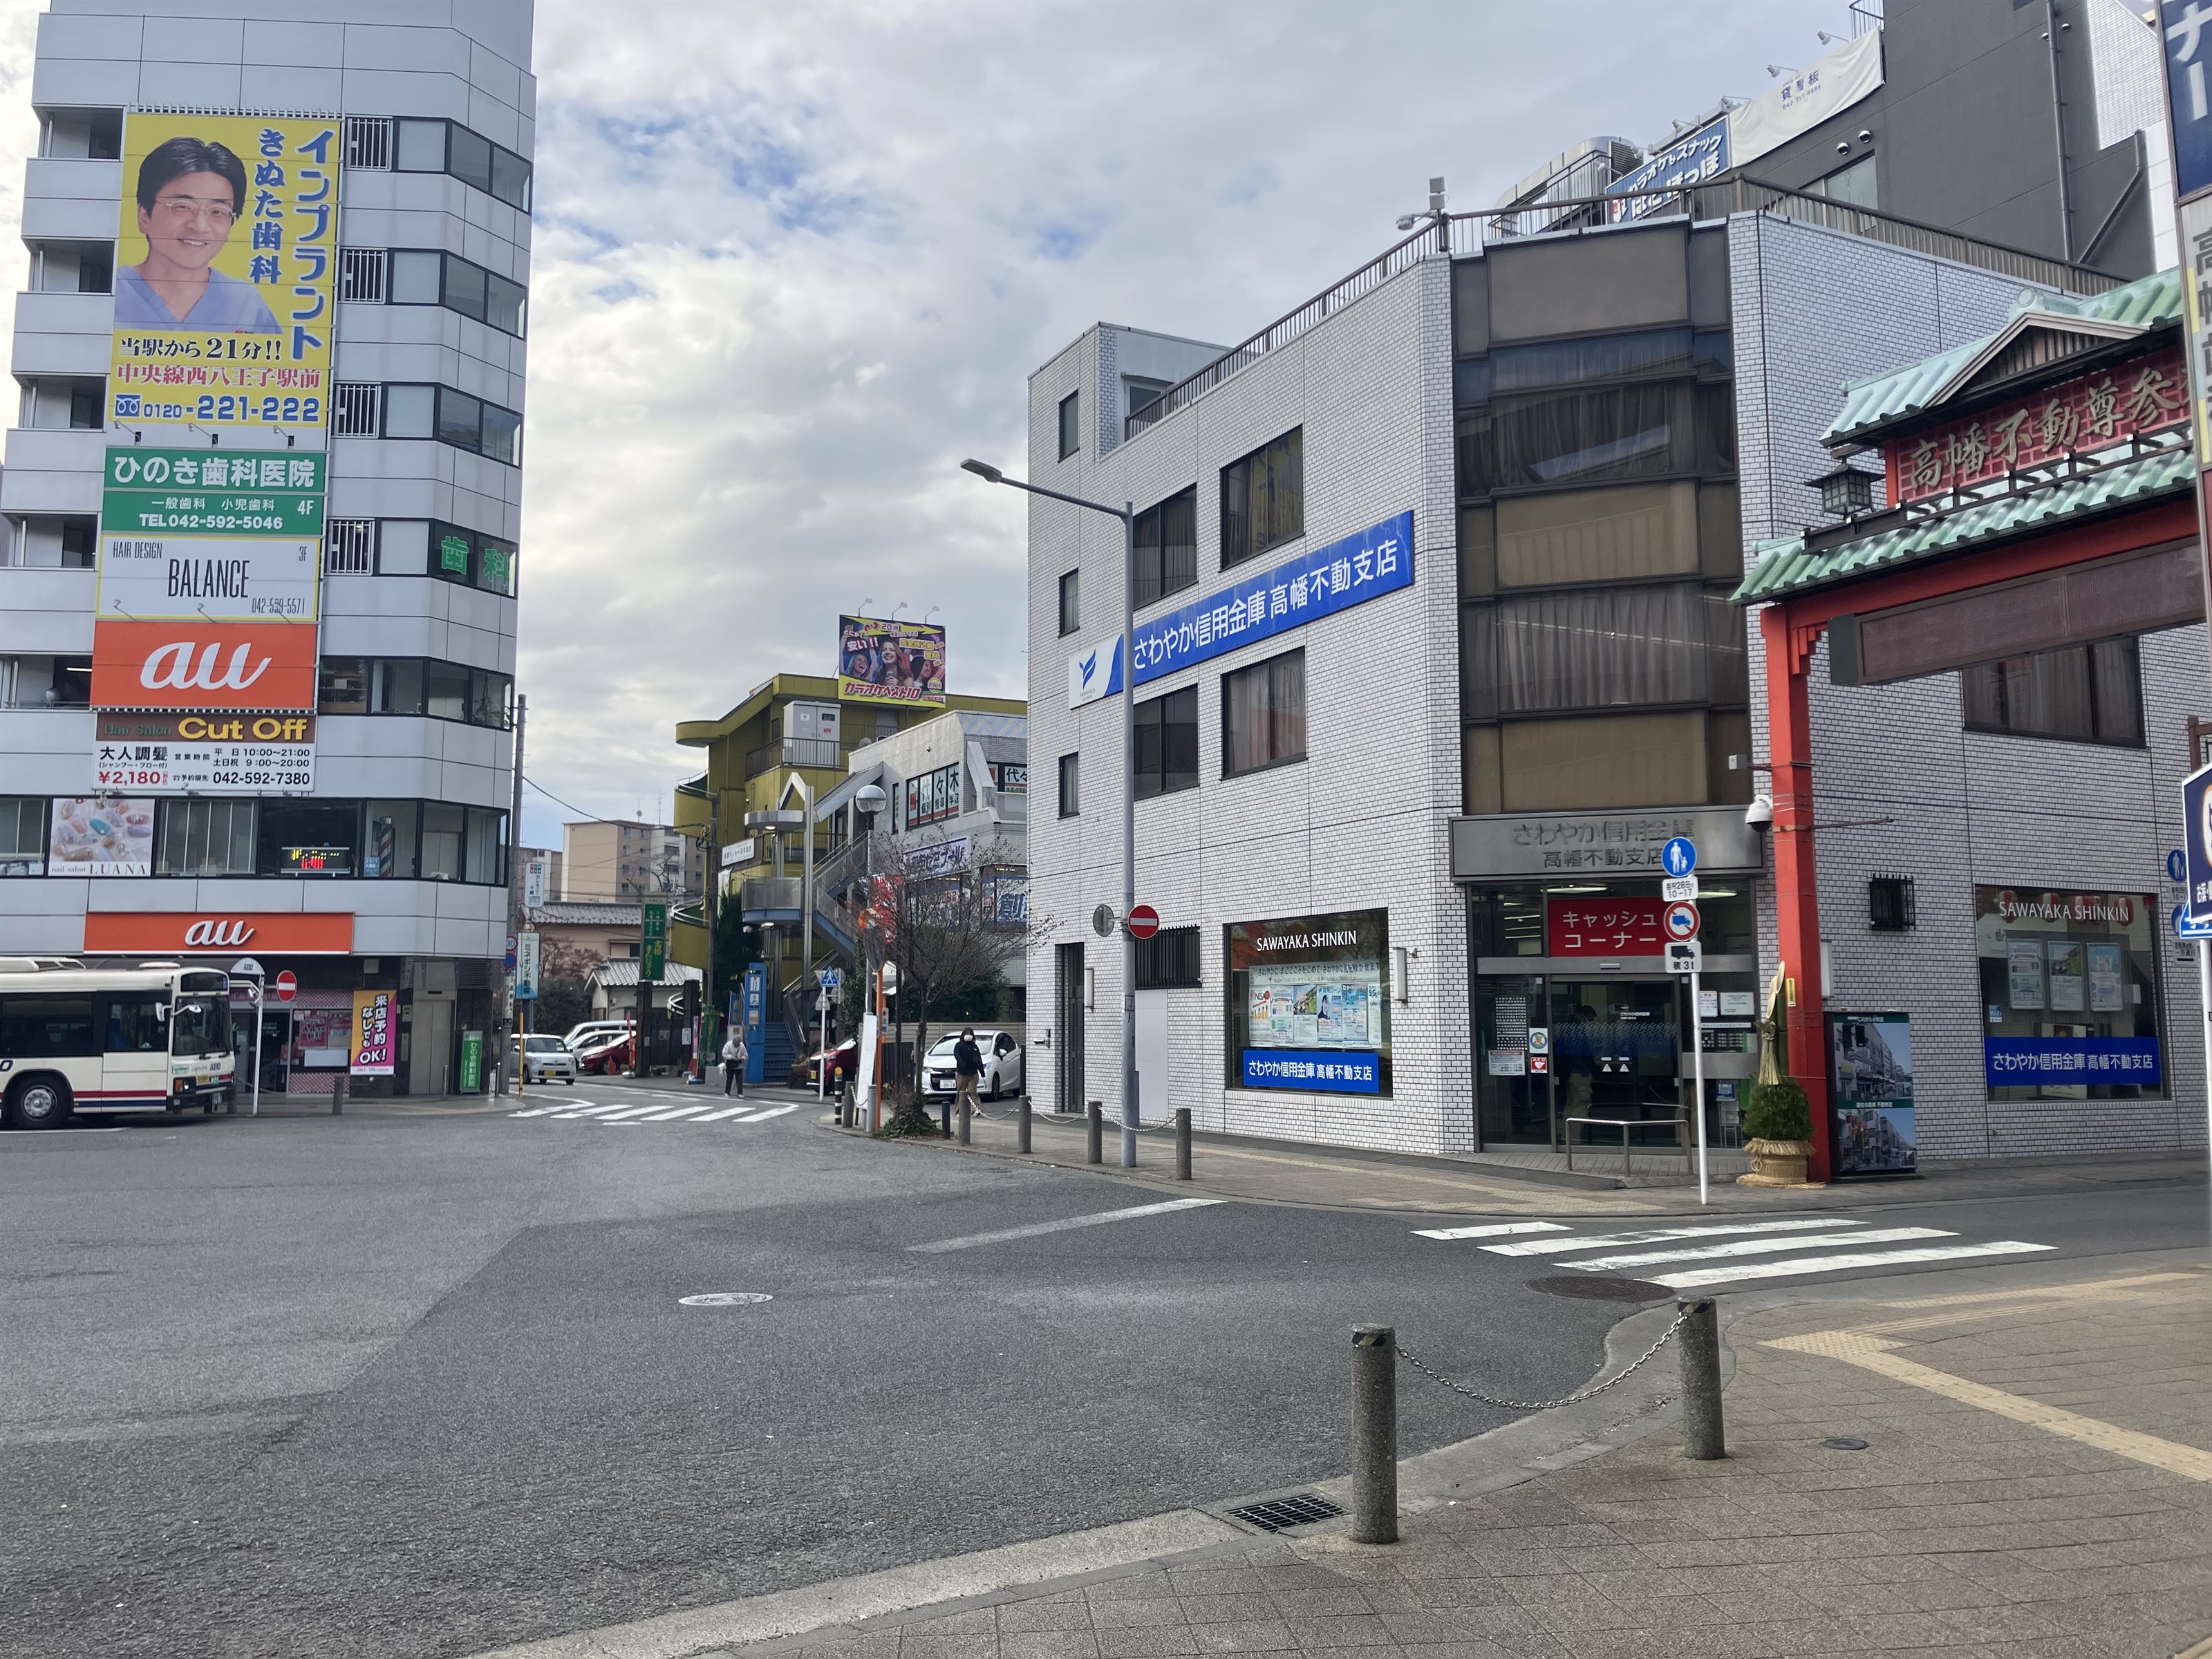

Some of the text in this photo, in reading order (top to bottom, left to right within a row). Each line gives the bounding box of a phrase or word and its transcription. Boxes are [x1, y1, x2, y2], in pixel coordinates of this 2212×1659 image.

[250, 128, 285, 285] きぬた歯科
[291, 130, 334, 360] インプラント
[119, 337, 281, 360] 当駅から21分!!
[118, 364, 321, 388] 中央線西八王子駅前
[144, 394, 320, 422] 0120-221-222
[1910, 366, 2193, 489] 高幡不動尊参
[115, 456, 315, 487] ひのき歯科医院
[151, 496, 274, 512] 一般歯科 小児歯科
[297, 500, 315, 515] 4F
[113, 541, 162, 559] HAIR DESIGN
[298, 546, 308, 561] 3F
[441, 536, 509, 586] 歯科
[167, 559, 250, 598] BALANCE
[1134, 539, 1398, 670] さわやか信用金庫 高幡不動支店
[844, 630, 863, 639] とにかく
[140, 641, 272, 690] au
[845, 682, 921, 700] カラオケベスト10
[104, 717, 308, 740] Hair Salon Cut Off
[100, 746, 168, 761] 大人調髪
[213, 758, 238, 767] 土日祝
[99, 771, 160, 786] ¥2,180
[213, 772, 310, 785] 042-592-7380
[921, 769, 959, 801] 代々木
[1512, 819, 1695, 847] さわやか信用金庫
[1543, 847, 1663, 868] 高幡不動支店
[90, 864, 146, 874] LUANA
[1669, 889, 1692, 898] 10-17
[998, 893, 1027, 919] 創
[1999, 901, 2130, 921] SAWAYAKA SHINKIN
[1562, 911, 1657, 928] キャッシュ
[185, 919, 254, 946] au
[1257, 930, 1357, 952] SAWAYAKA SHINKIN
[1564, 932, 1657, 949] コーナー
[362, 1006, 374, 1047] なしでも
[374, 994, 388, 1044] 来店予約
[359, 1048, 386, 1064] OK!
[1994, 1053, 2153, 1070] さわやか信用金庫 高幡不動支店
[1249, 1060, 1372, 1081] さわやか信用金庫 高幡不動支店
